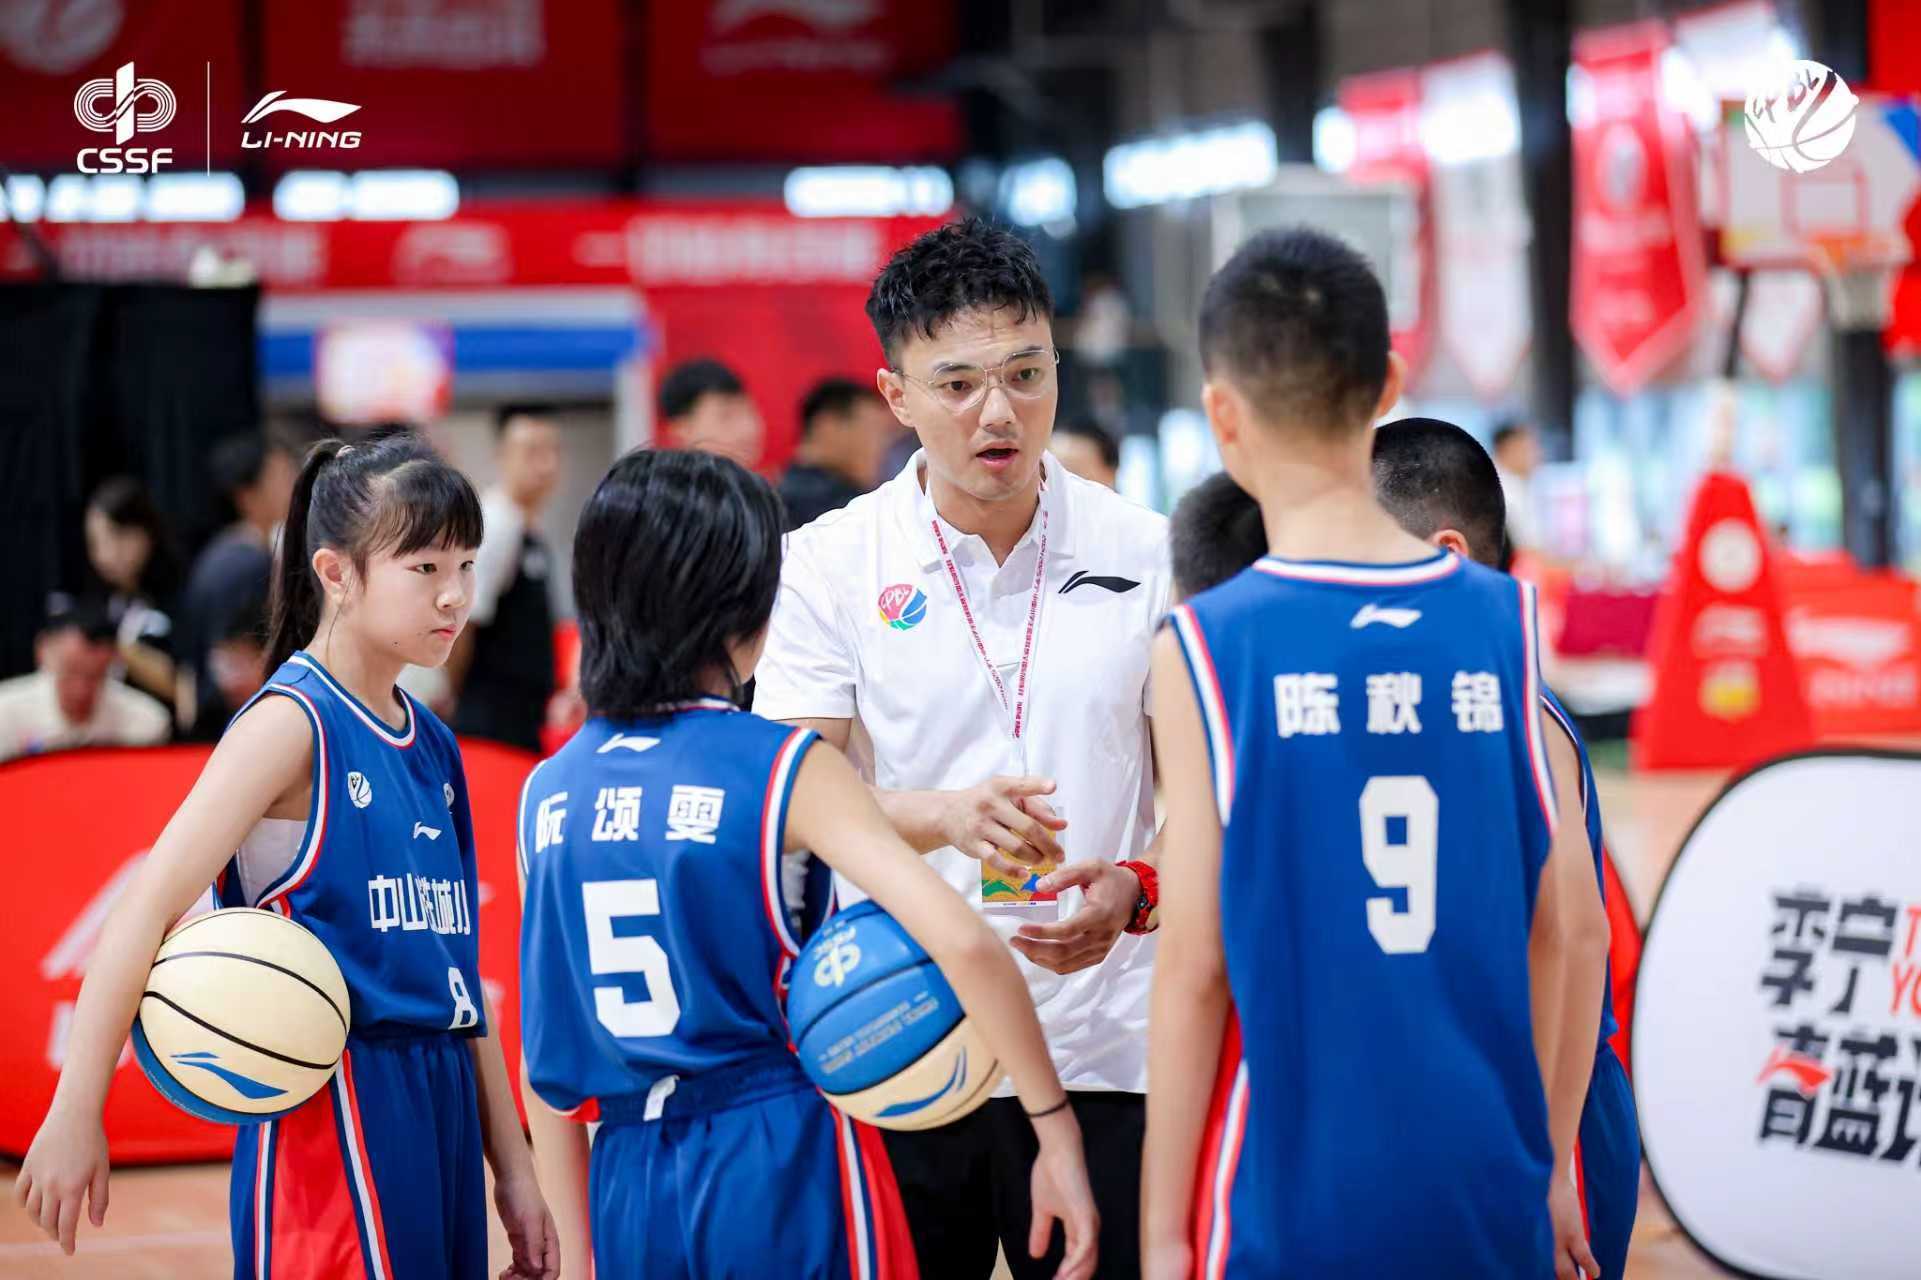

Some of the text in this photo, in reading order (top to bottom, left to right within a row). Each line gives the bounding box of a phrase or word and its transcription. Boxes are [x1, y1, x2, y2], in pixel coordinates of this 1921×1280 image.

[1274, 670, 1504, 738] 陈秋锦
[535, 785, 725, 853] 阮颂雯
[1359, 775, 1439, 954] 9
[582, 879, 681, 1038] 5
[447, 966, 479, 1031] 8
